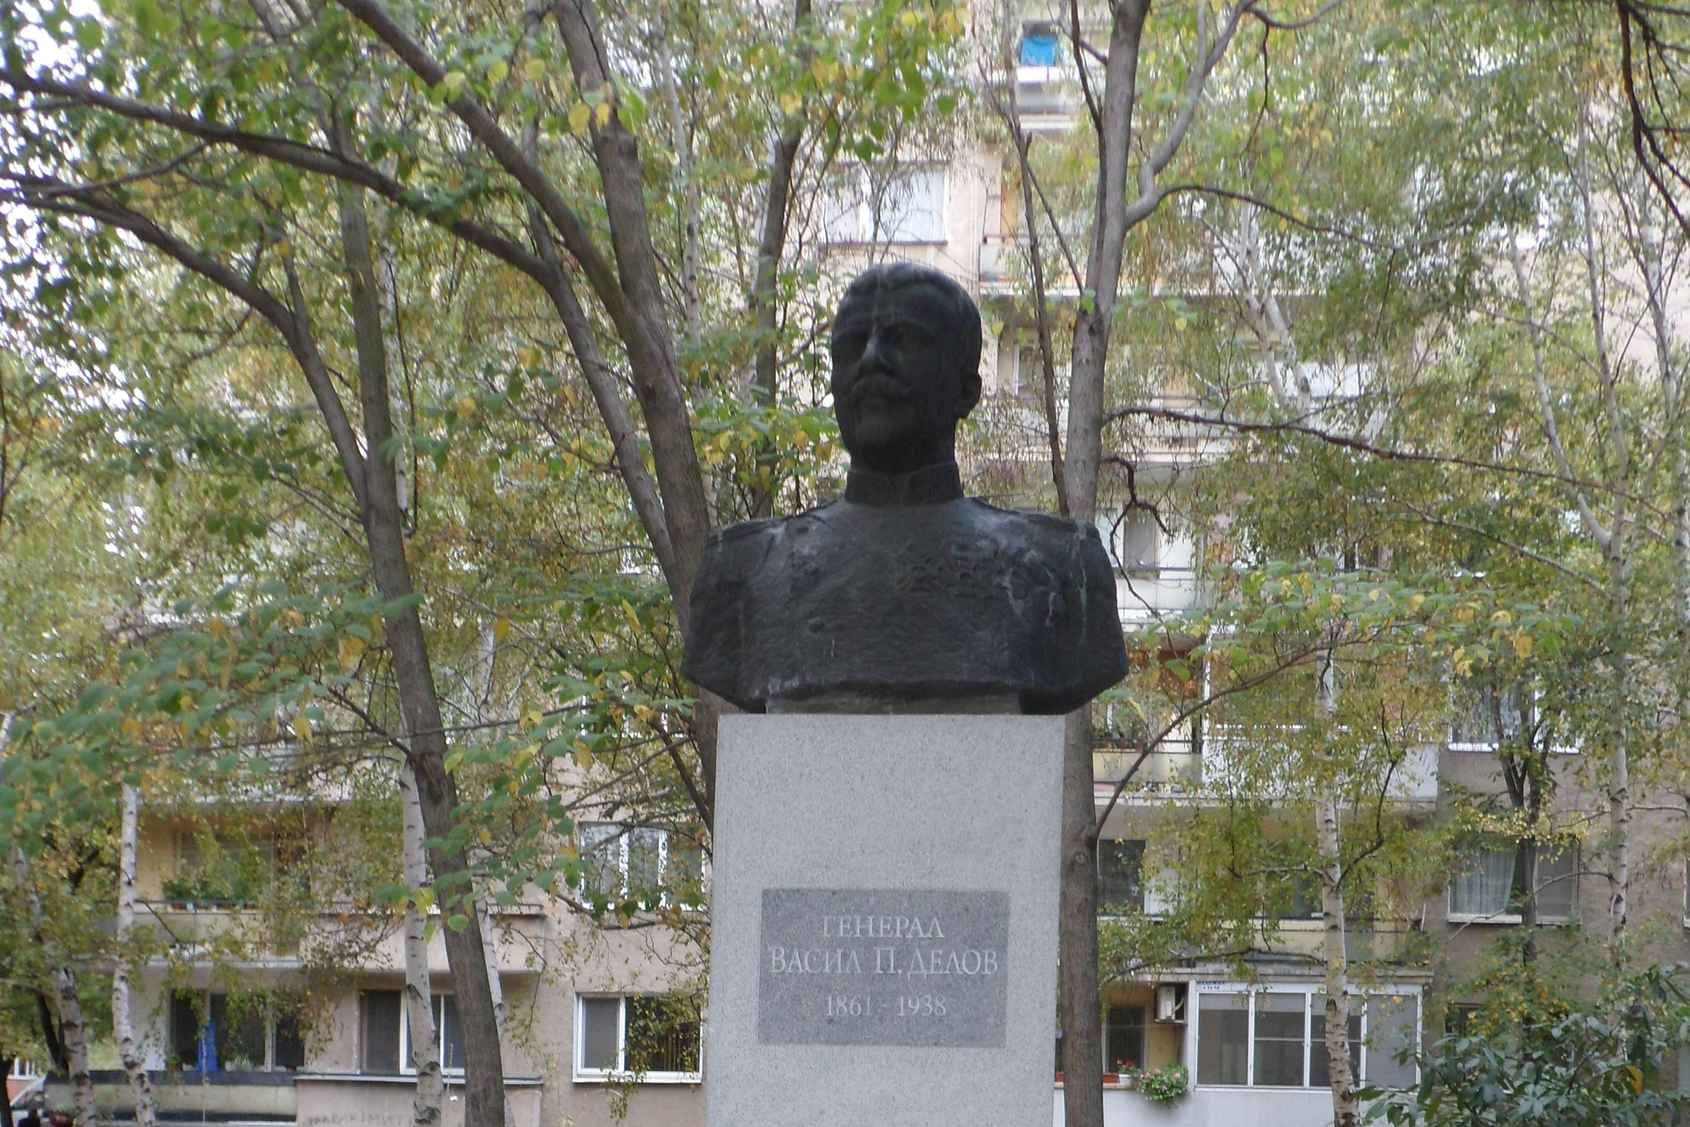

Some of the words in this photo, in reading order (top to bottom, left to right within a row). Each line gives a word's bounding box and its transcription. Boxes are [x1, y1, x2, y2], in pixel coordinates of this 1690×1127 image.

[823, 915, 944, 938] ГЕНЕРАЛ
[768, 947, 862, 974] ВАСИЛ
[873, 947, 902, 974] П.
[907, 949, 999, 980] ДЕЛОВ
[825, 995, 873, 1017] 1861
[897, 996, 947, 1017] 1938
